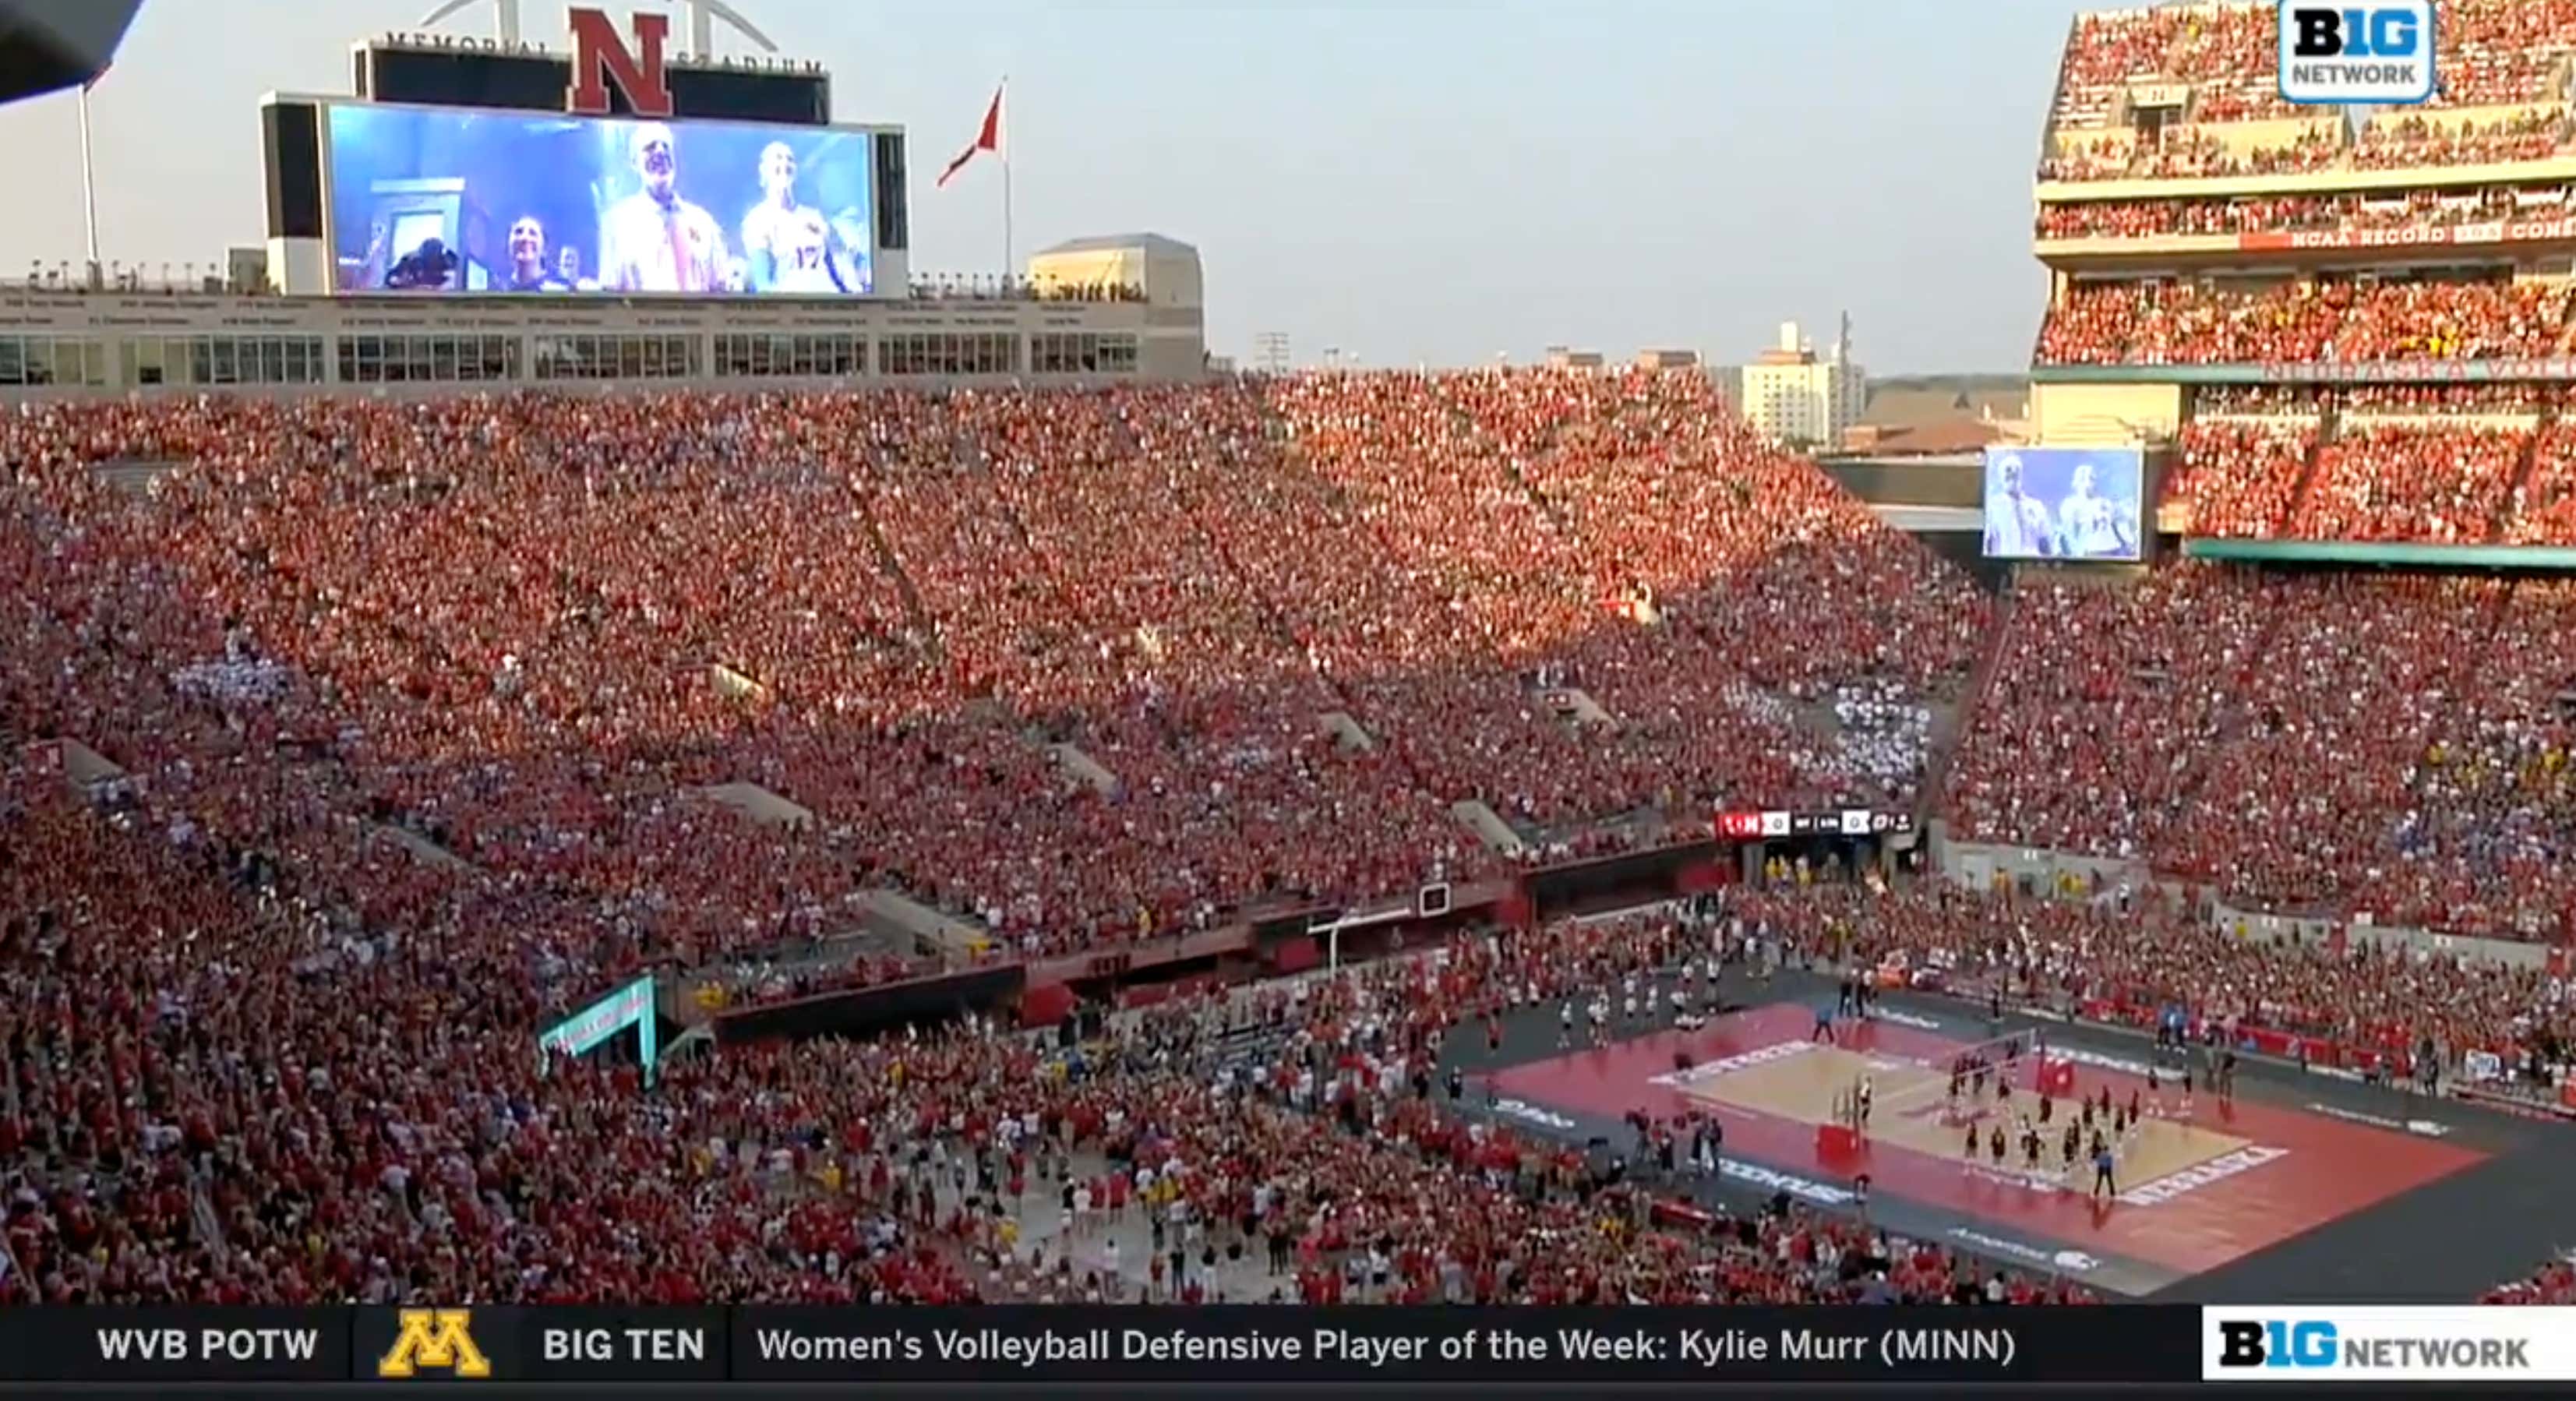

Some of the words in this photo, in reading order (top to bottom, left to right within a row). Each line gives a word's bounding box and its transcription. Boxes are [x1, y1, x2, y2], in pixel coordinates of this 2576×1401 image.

[386, 31, 545, 56] MEMORIAL
[566, 7, 674, 116] N
[677, 51, 821, 74] STADIUM
[2292, 228, 2350, 248] NCAA
[2361, 224, 2445, 246] RECORD
[797, 246, 820, 269] 17
